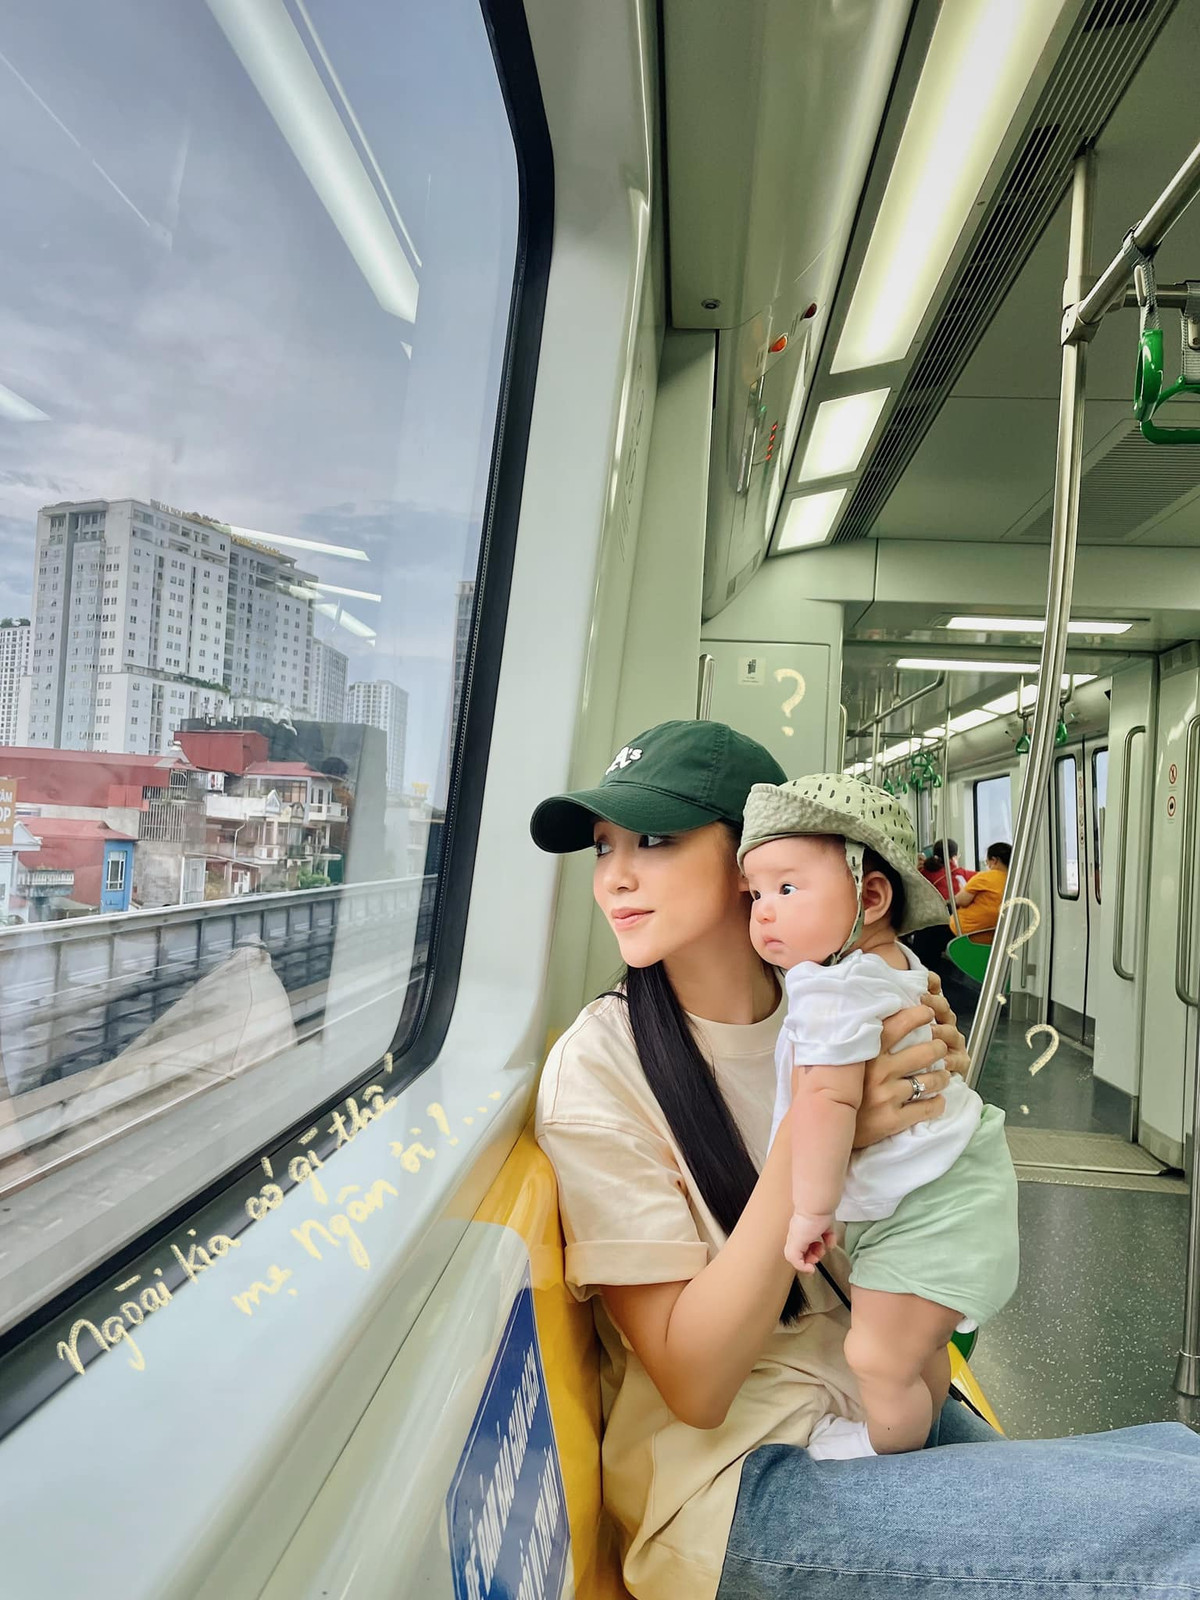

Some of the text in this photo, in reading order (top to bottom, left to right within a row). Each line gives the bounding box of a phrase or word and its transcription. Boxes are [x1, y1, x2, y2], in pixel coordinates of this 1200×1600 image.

[605, 746, 643, 775] A's
[476, 1472, 502, 1596] ĐẢM
[494, 1420, 514, 1530] BẢO
[521, 1341, 540, 1430] CÁCH
[542, 1444, 559, 1534] NÀY
[534, 1472, 551, 1574] TRÍ
